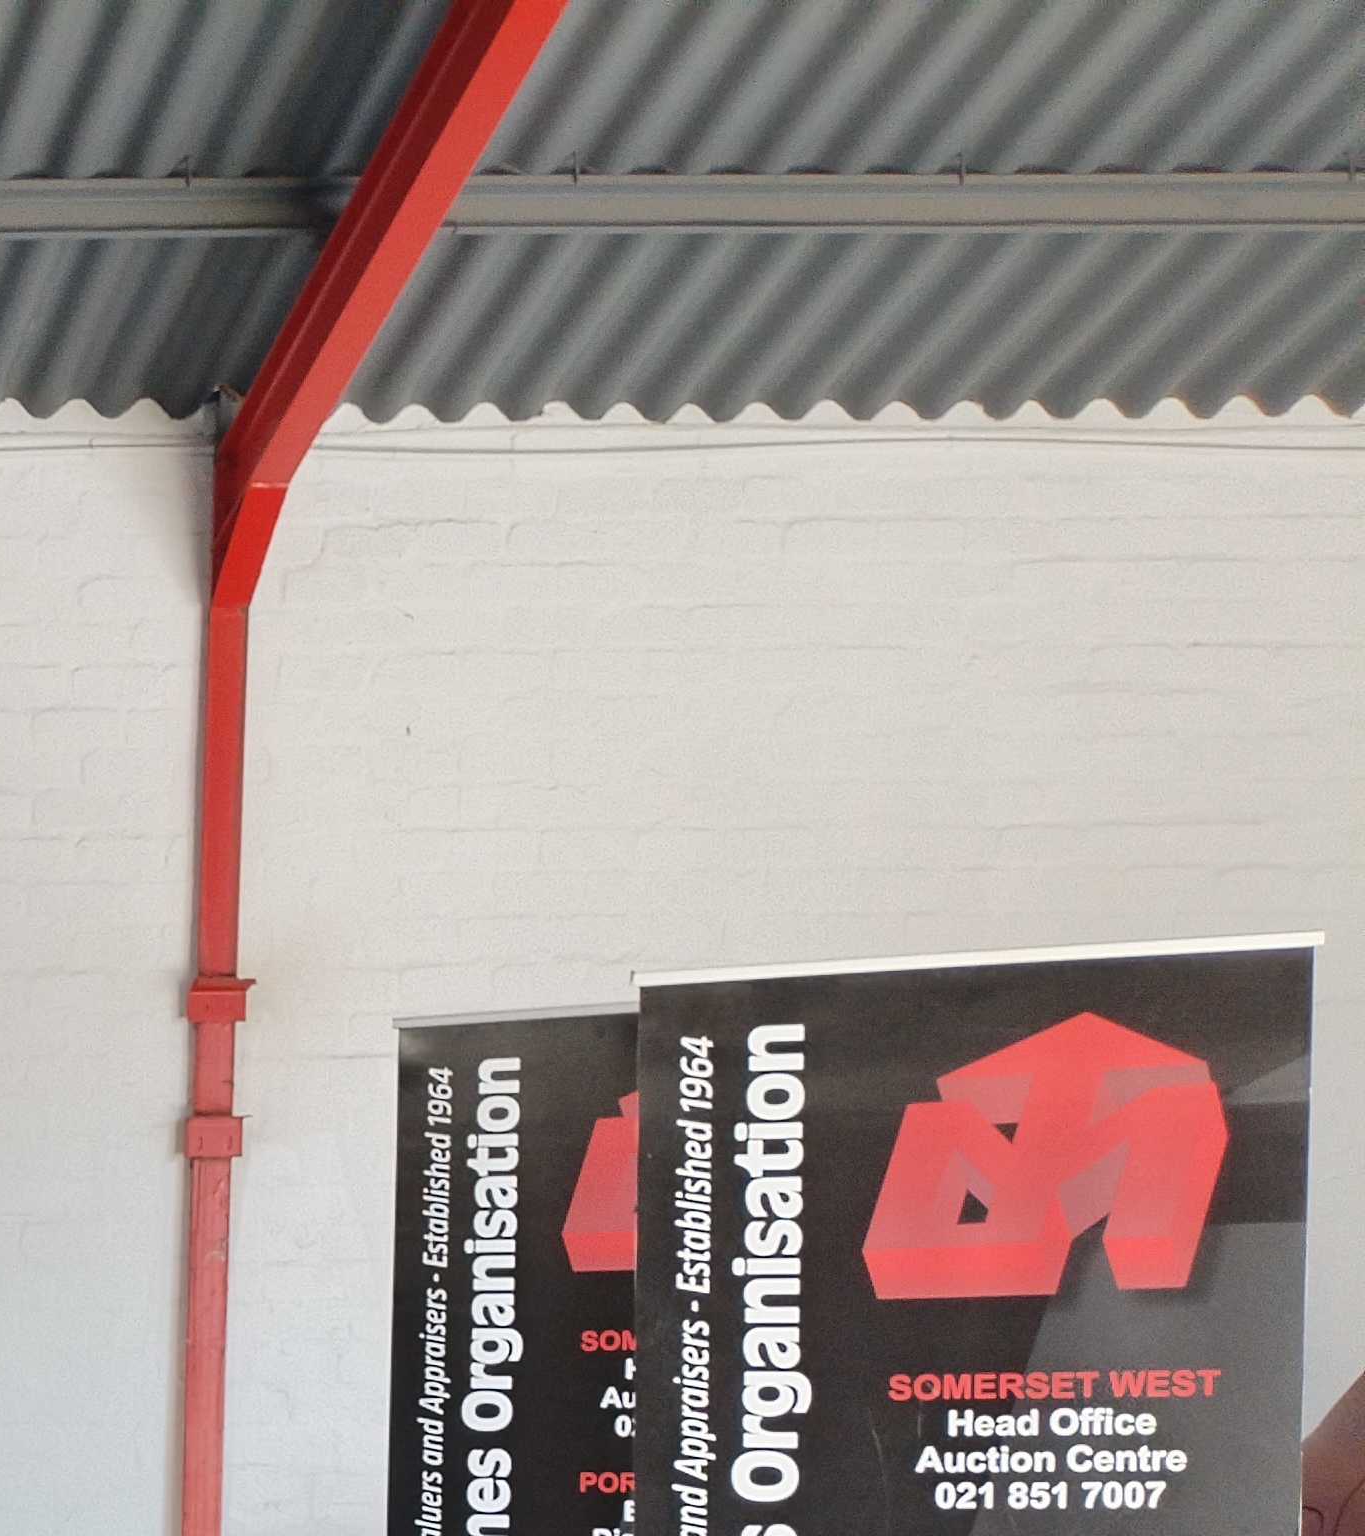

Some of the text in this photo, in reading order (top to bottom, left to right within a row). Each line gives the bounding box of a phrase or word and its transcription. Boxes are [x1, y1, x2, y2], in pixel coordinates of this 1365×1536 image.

[428, 1067, 453, 1125] 1964
[679, 1035, 715, 1111] 1964
[422, 1132, 451, 1267] Established
[674, 1118, 712, 1294] Established
[462, 1057, 523, 1431] Organisation
[731, 1024, 812, 1502] Organisation
[419, 1288, 451, 1415] Appraisers
[889, 1370, 1221, 1400] SOMERSET WEST
[673, 1320, 716, 1481] Appraisers
[948, 1408, 1157, 1437] Head Office
[417, 1418, 443, 1465] and
[915, 1444, 1187, 1473] Auction Centre
[580, 1472, 635, 1493] POR
[935, 1481, 1166, 1509] 021 851 7007
